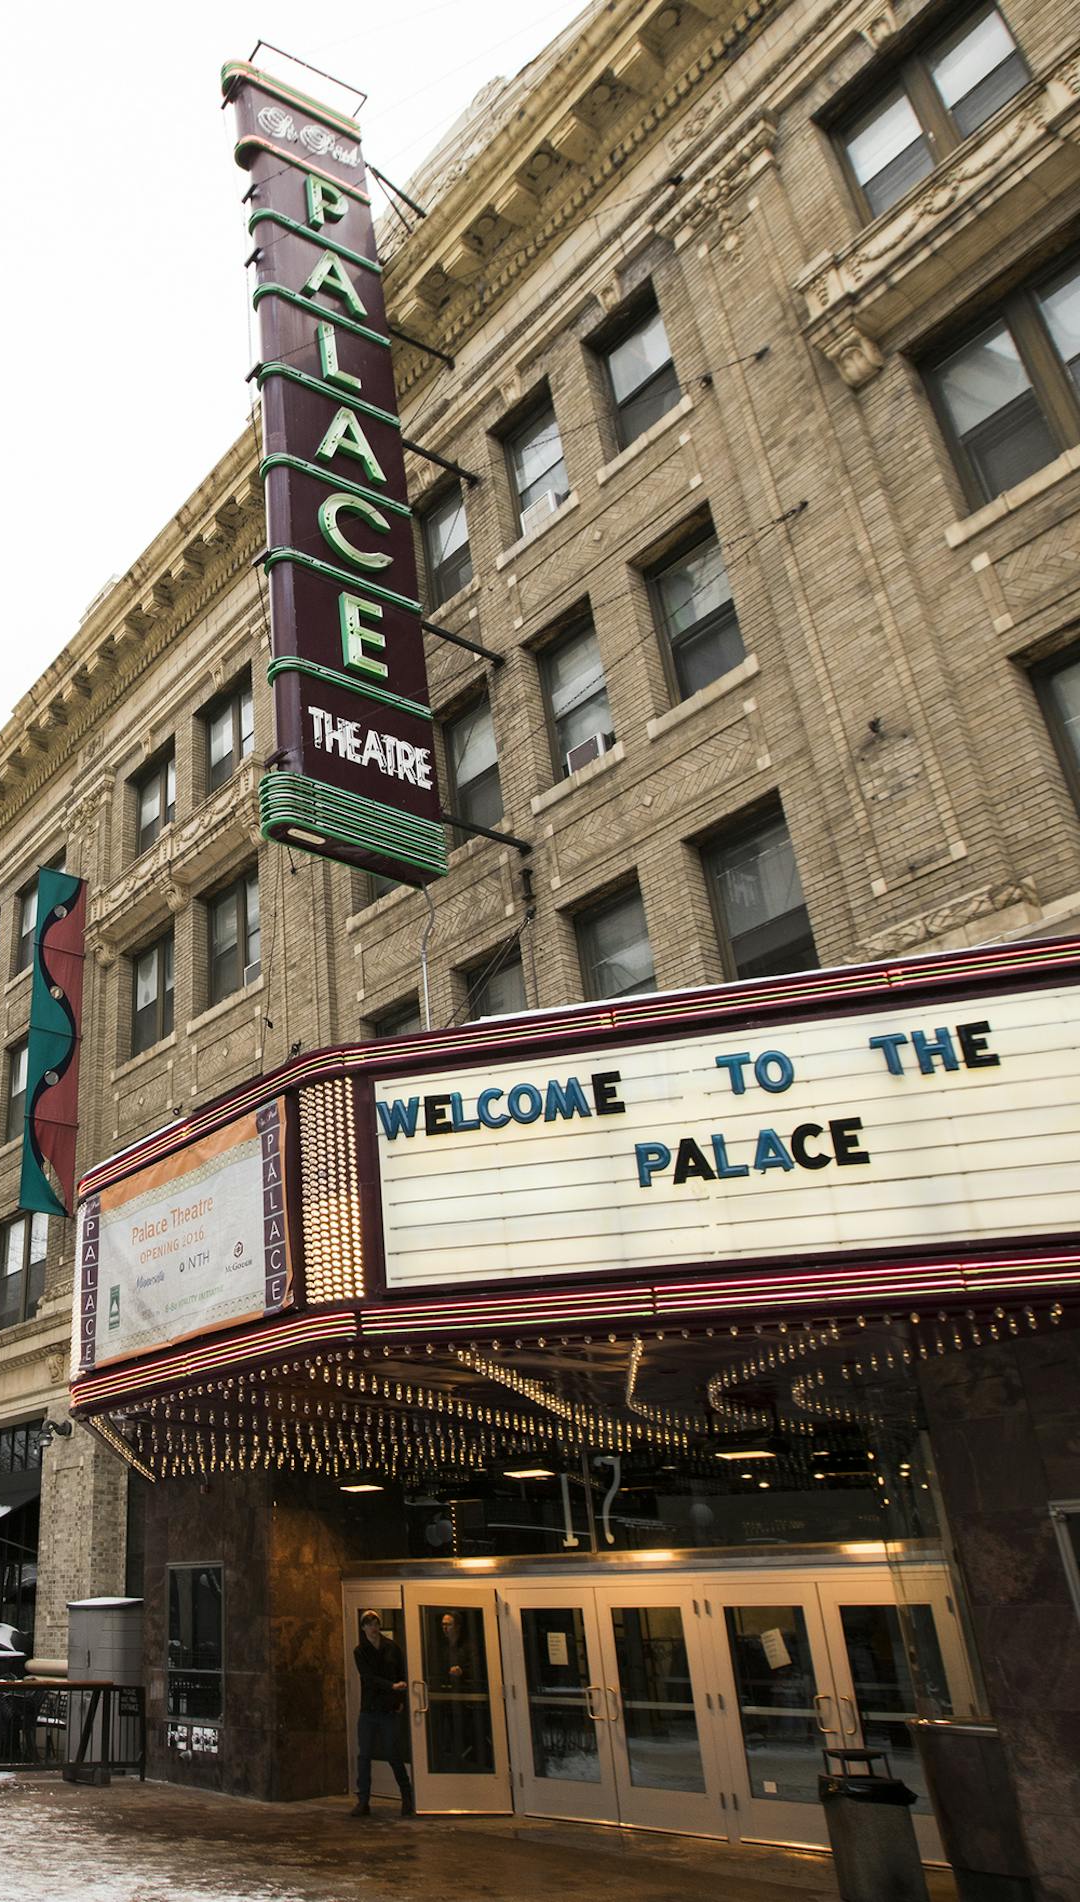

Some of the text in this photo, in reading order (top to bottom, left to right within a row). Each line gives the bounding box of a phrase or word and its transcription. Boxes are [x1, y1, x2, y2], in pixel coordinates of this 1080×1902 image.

[300, 173, 394, 682] PALACE
[307, 705, 433, 791] THEATRE
[376, 1020, 1001, 1141] WELCOME TO THE
[634, 1116, 871, 1187] PALACE
[131, 1197, 214, 1246] Palace Theatre
[140, 1239, 180, 1265] OPENING
[267, 1133, 283, 1301] PALACE
[84, 1220, 97, 1362] PALACE
